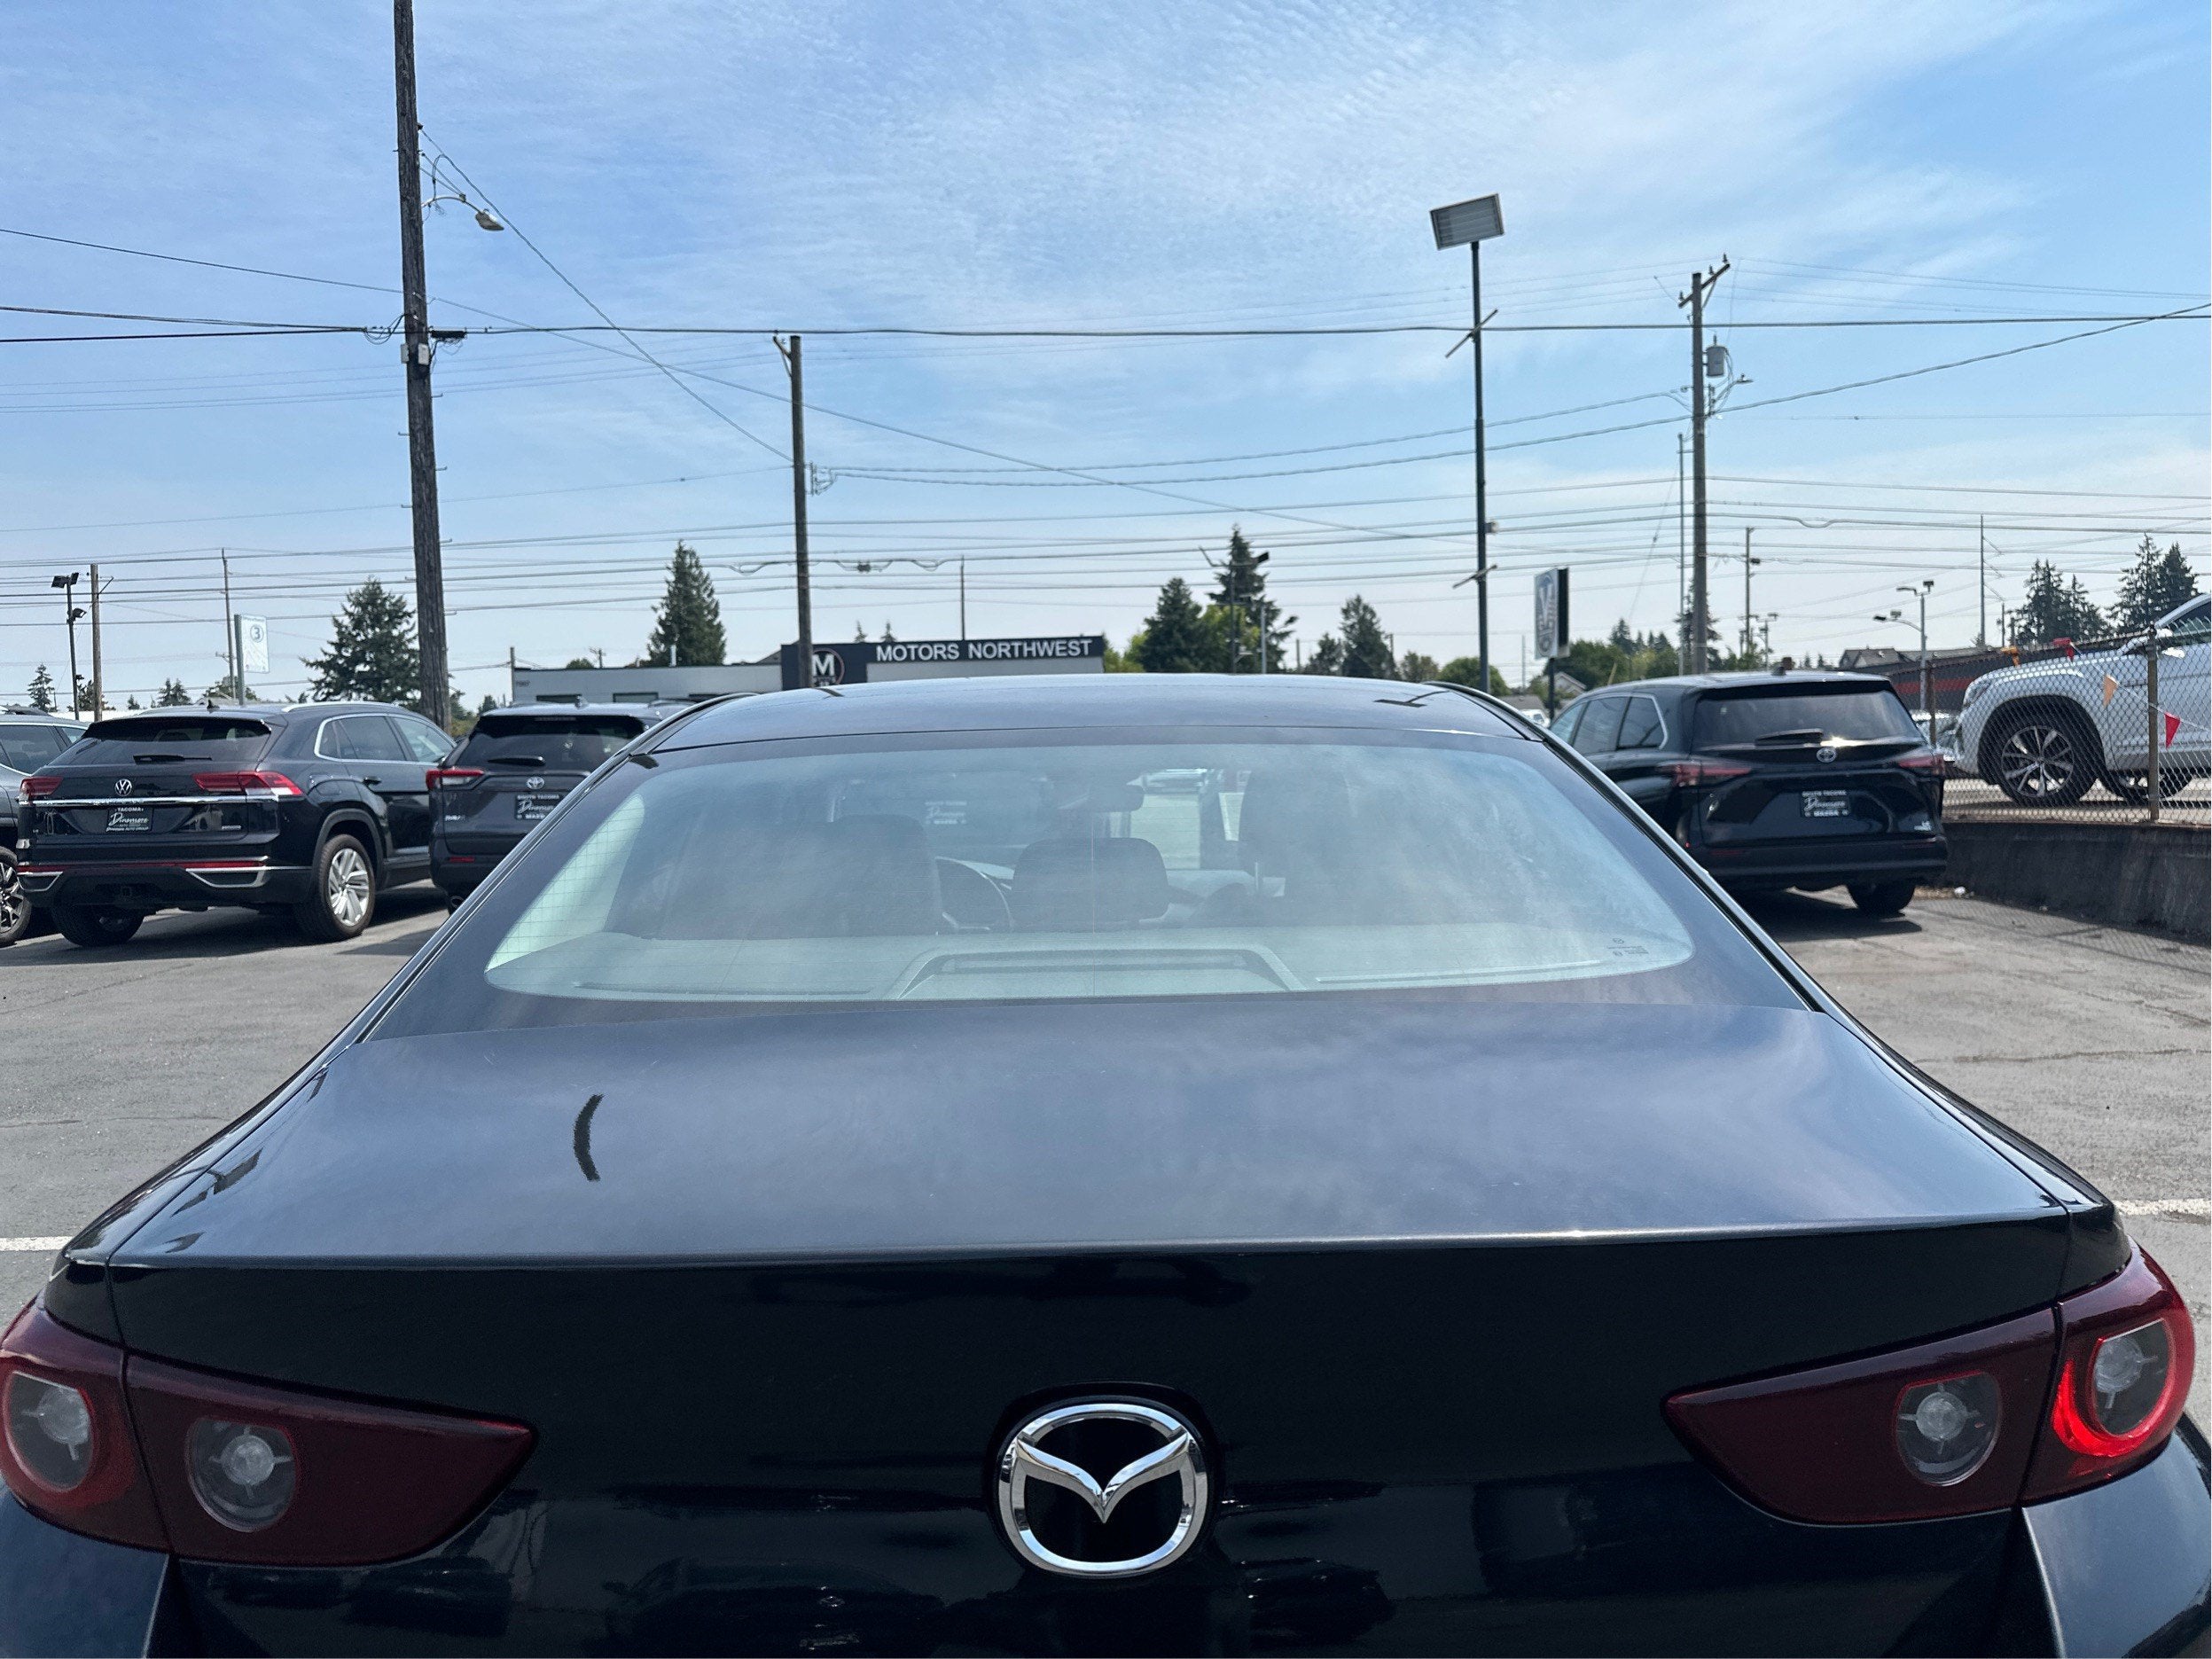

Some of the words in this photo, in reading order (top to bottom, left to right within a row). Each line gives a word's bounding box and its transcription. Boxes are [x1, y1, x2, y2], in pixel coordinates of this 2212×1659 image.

[876, 643, 960, 661] MOTORS
[968, 639, 1092, 659] NORTHWEST
[812, 653, 835, 677] M
